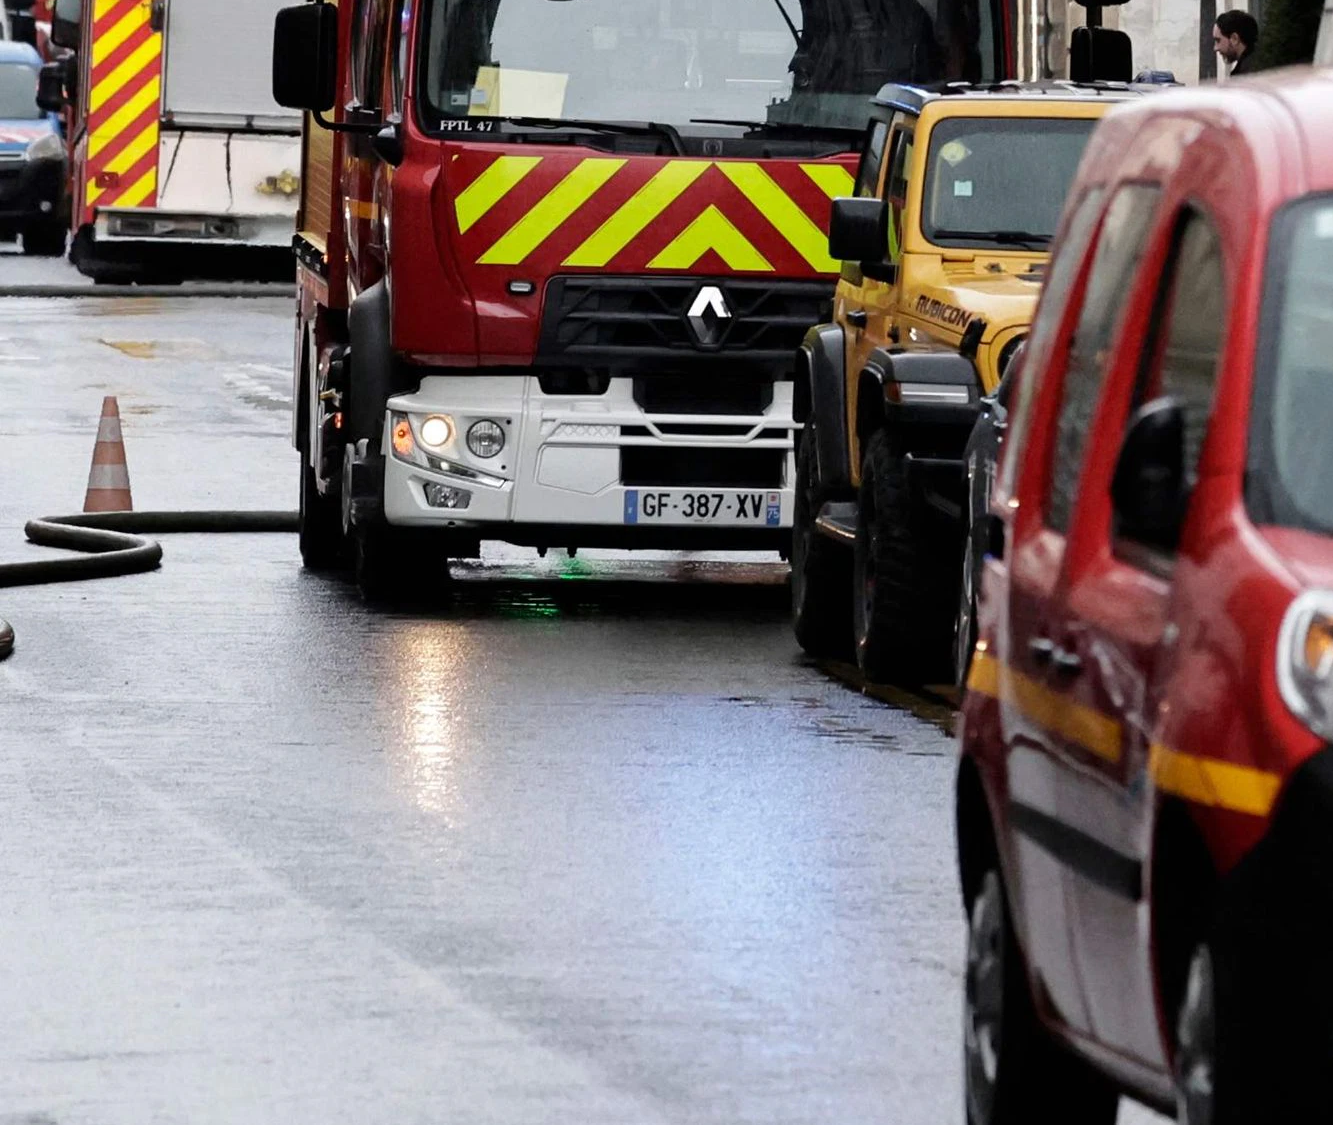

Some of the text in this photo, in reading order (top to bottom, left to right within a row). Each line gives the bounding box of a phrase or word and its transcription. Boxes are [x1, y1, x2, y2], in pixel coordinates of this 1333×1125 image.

[440, 120, 493, 131] FPTL 47
[916, 294, 972, 328] RUBICON
[642, 493, 779, 518] GF-387-XV 75
